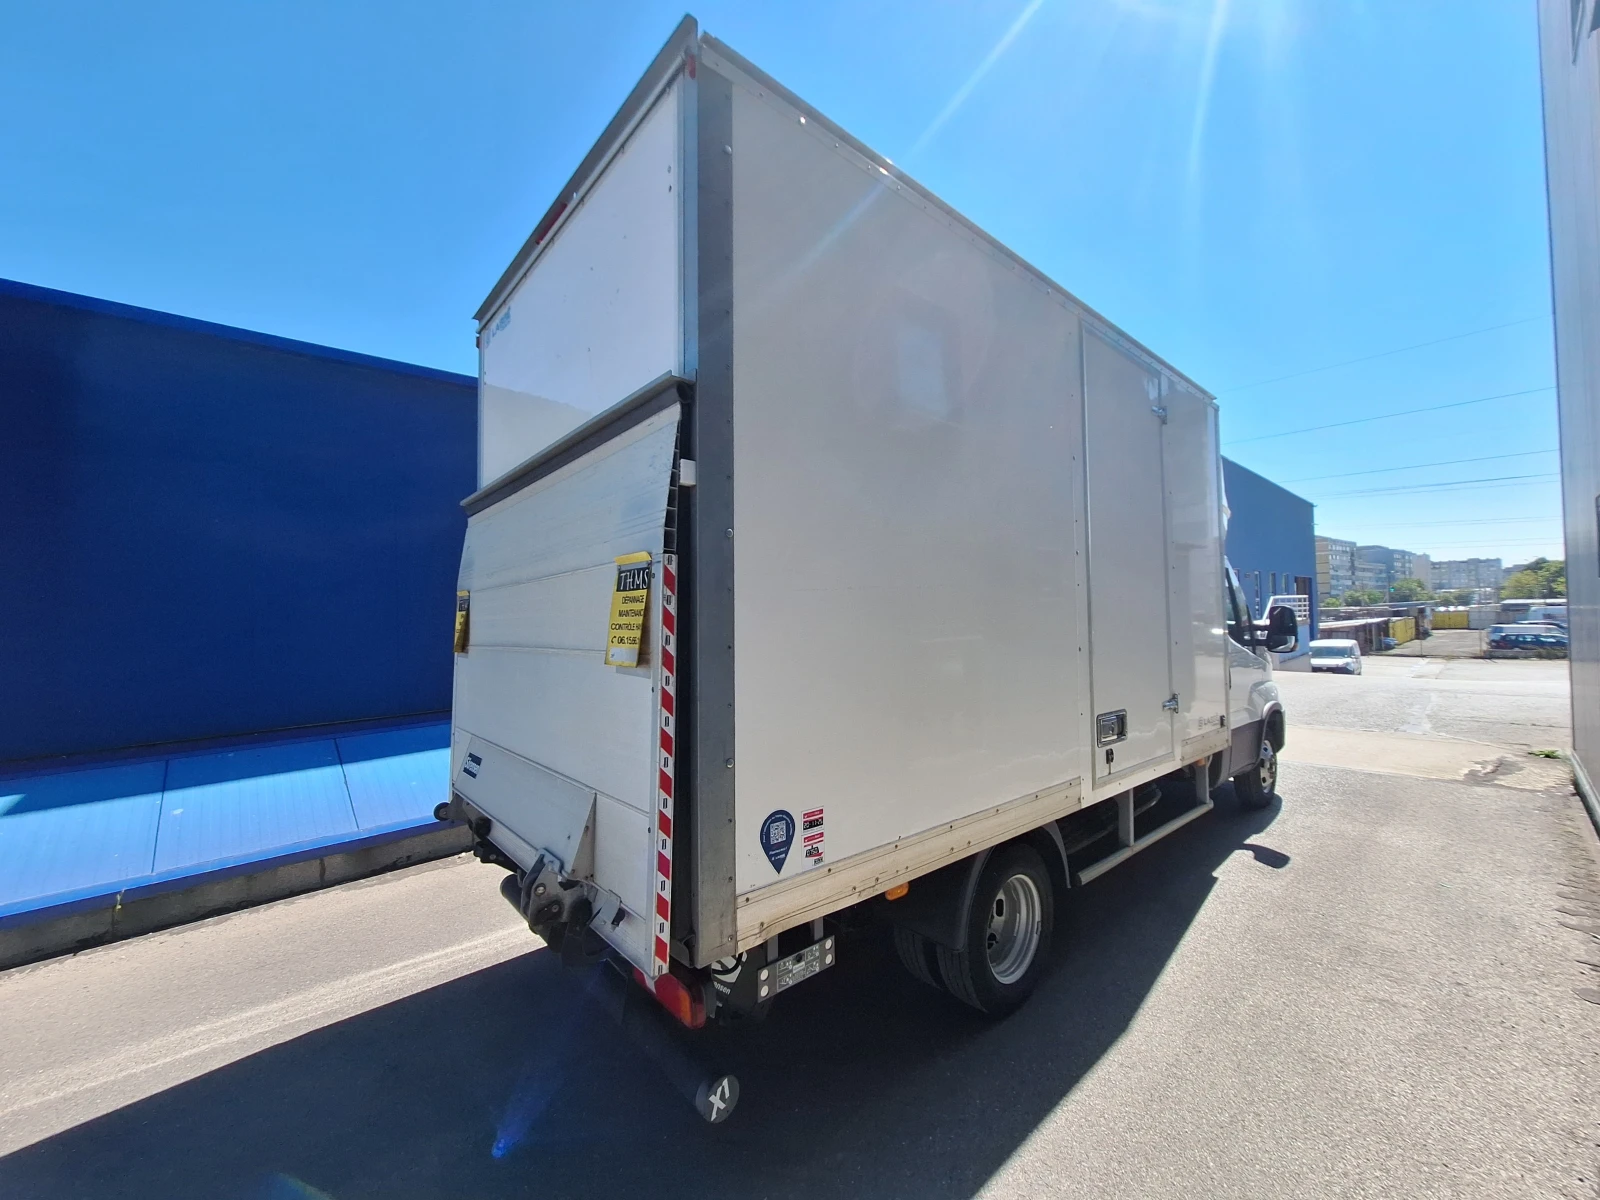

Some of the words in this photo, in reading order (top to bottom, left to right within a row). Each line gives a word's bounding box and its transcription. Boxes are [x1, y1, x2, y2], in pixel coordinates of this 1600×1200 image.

[620, 568, 649, 591] THMS
[621, 594, 645, 605] DÉPANNAGE
[618, 608, 644, 618] MAINTENANC
[610, 621, 635, 631] CONTRÔLE
[713, 980, 731, 996] ensen
